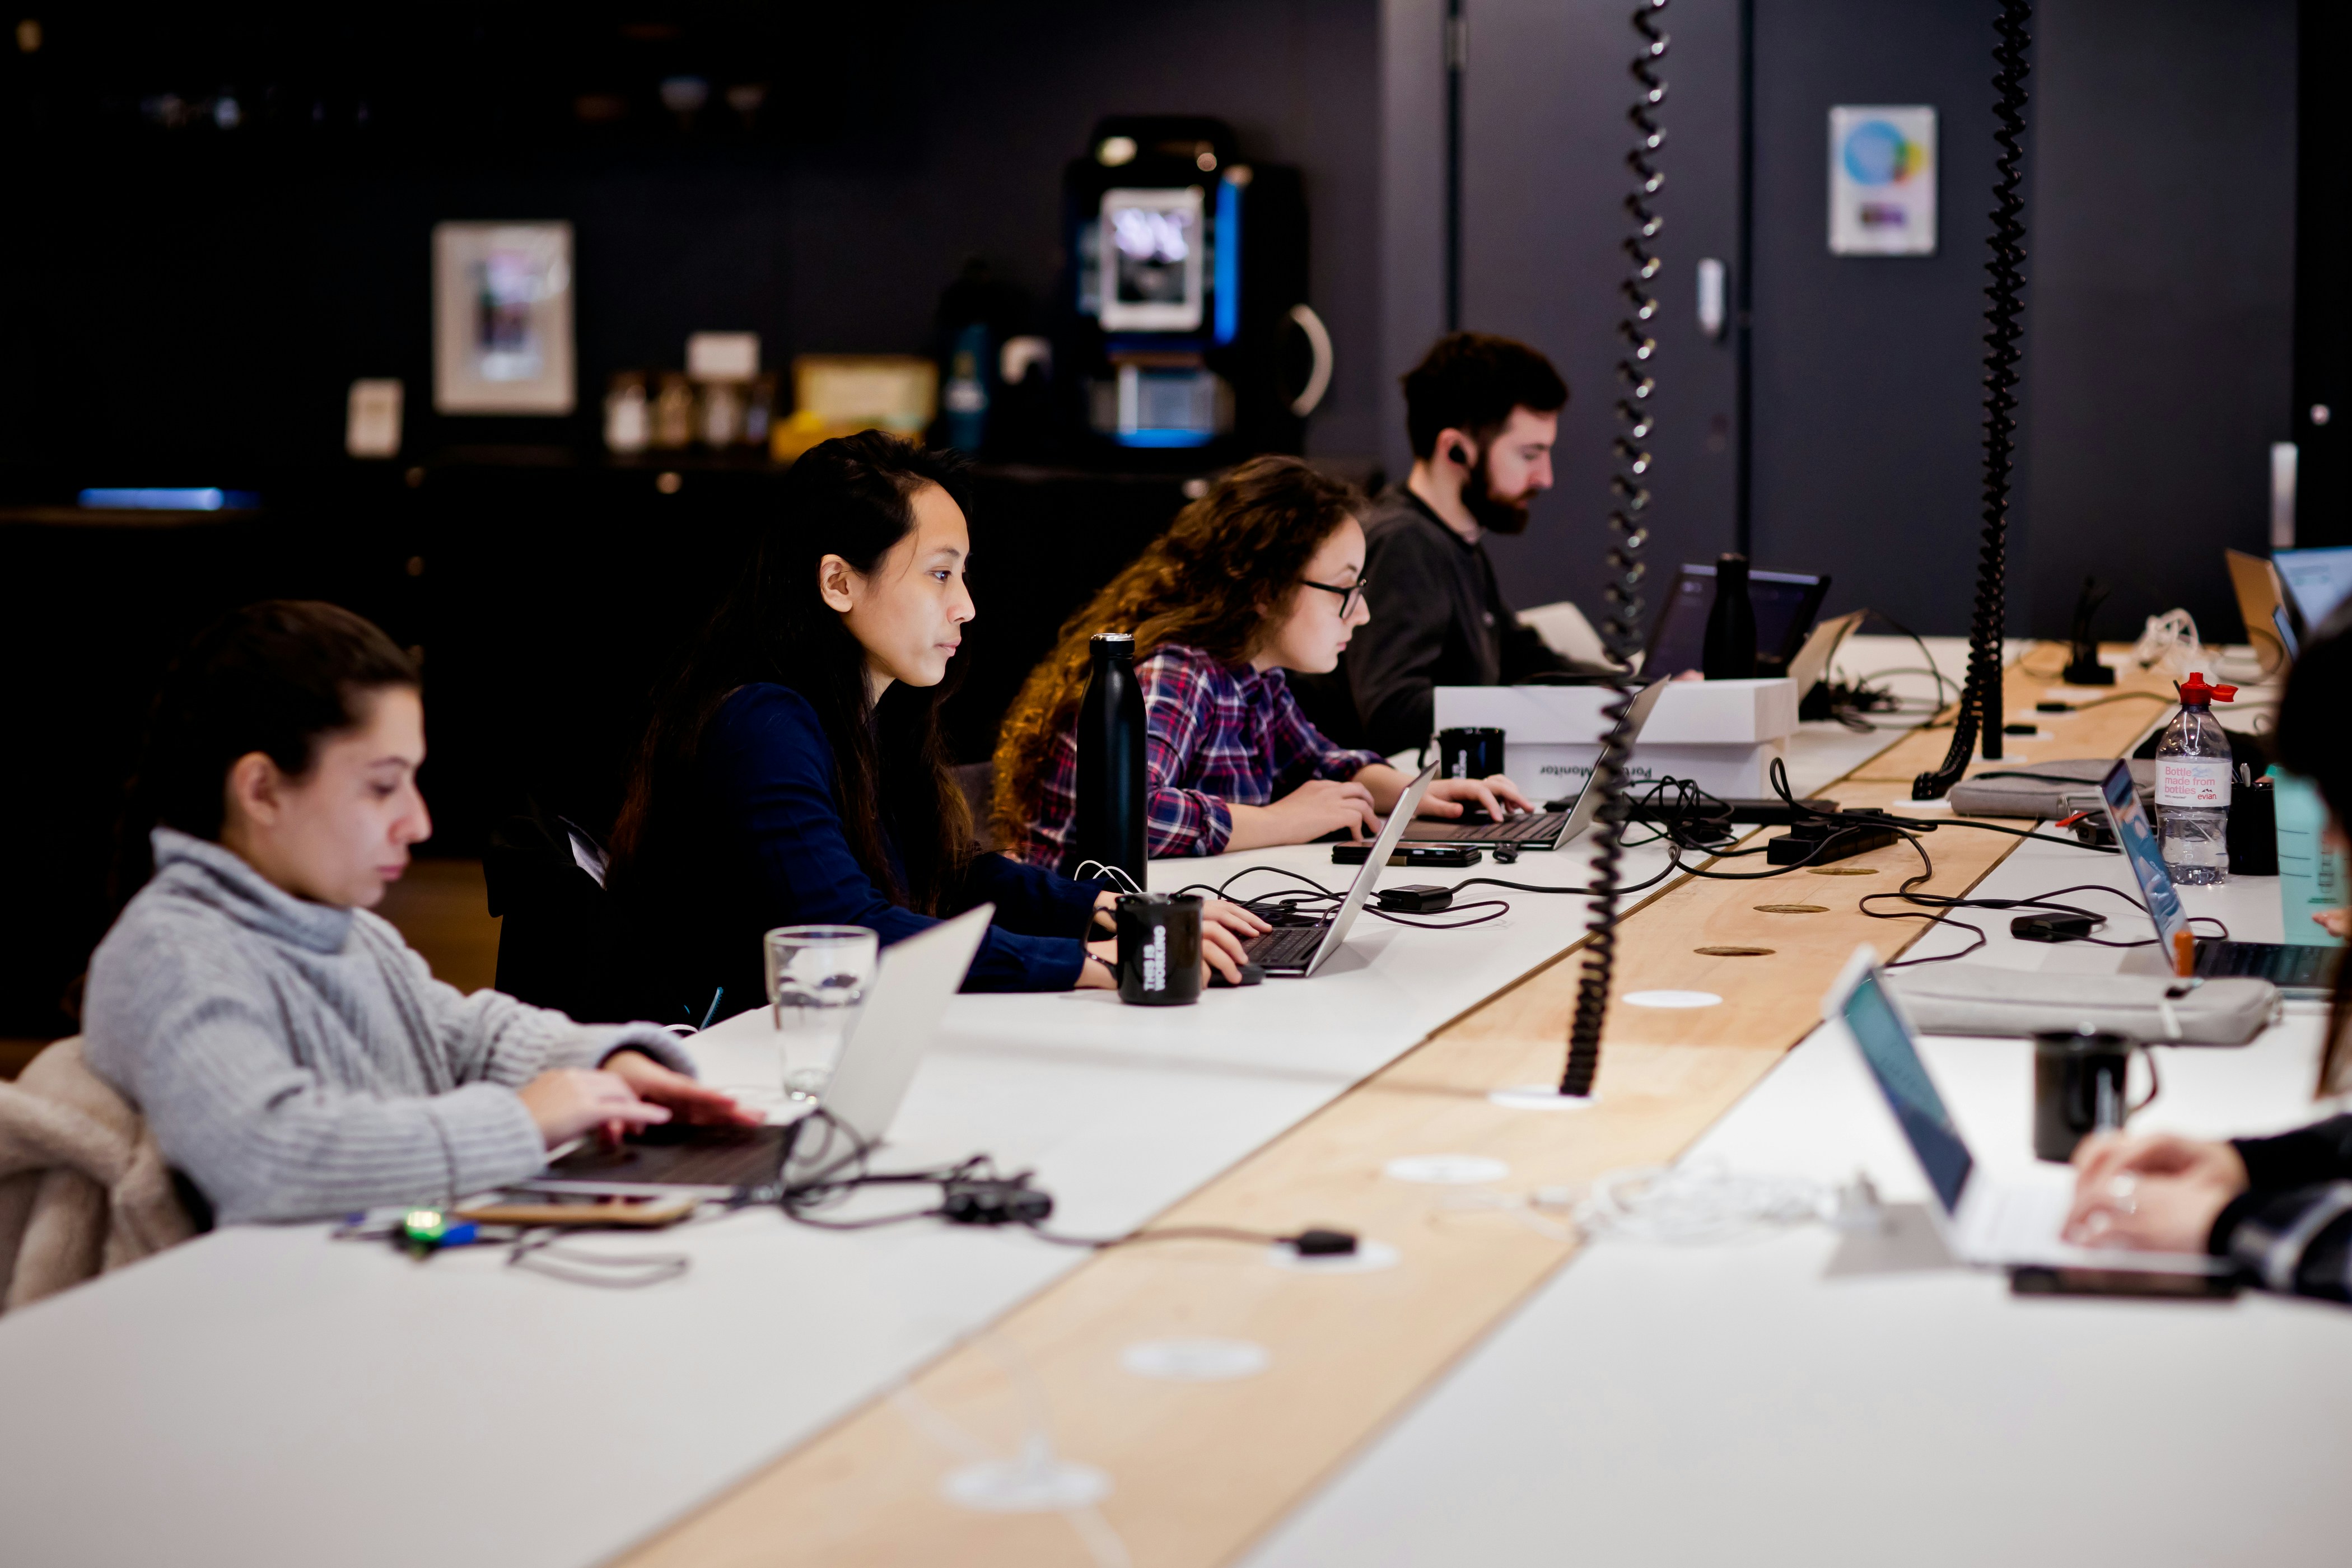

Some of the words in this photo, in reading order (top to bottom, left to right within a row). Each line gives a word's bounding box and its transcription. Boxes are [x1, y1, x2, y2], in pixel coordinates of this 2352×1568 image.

[1541, 764, 1593, 778] Monitor
[2166, 766, 2192, 776] Bottle
[2193, 777, 2215, 786] from
[2164, 785, 2196, 795] bottles
